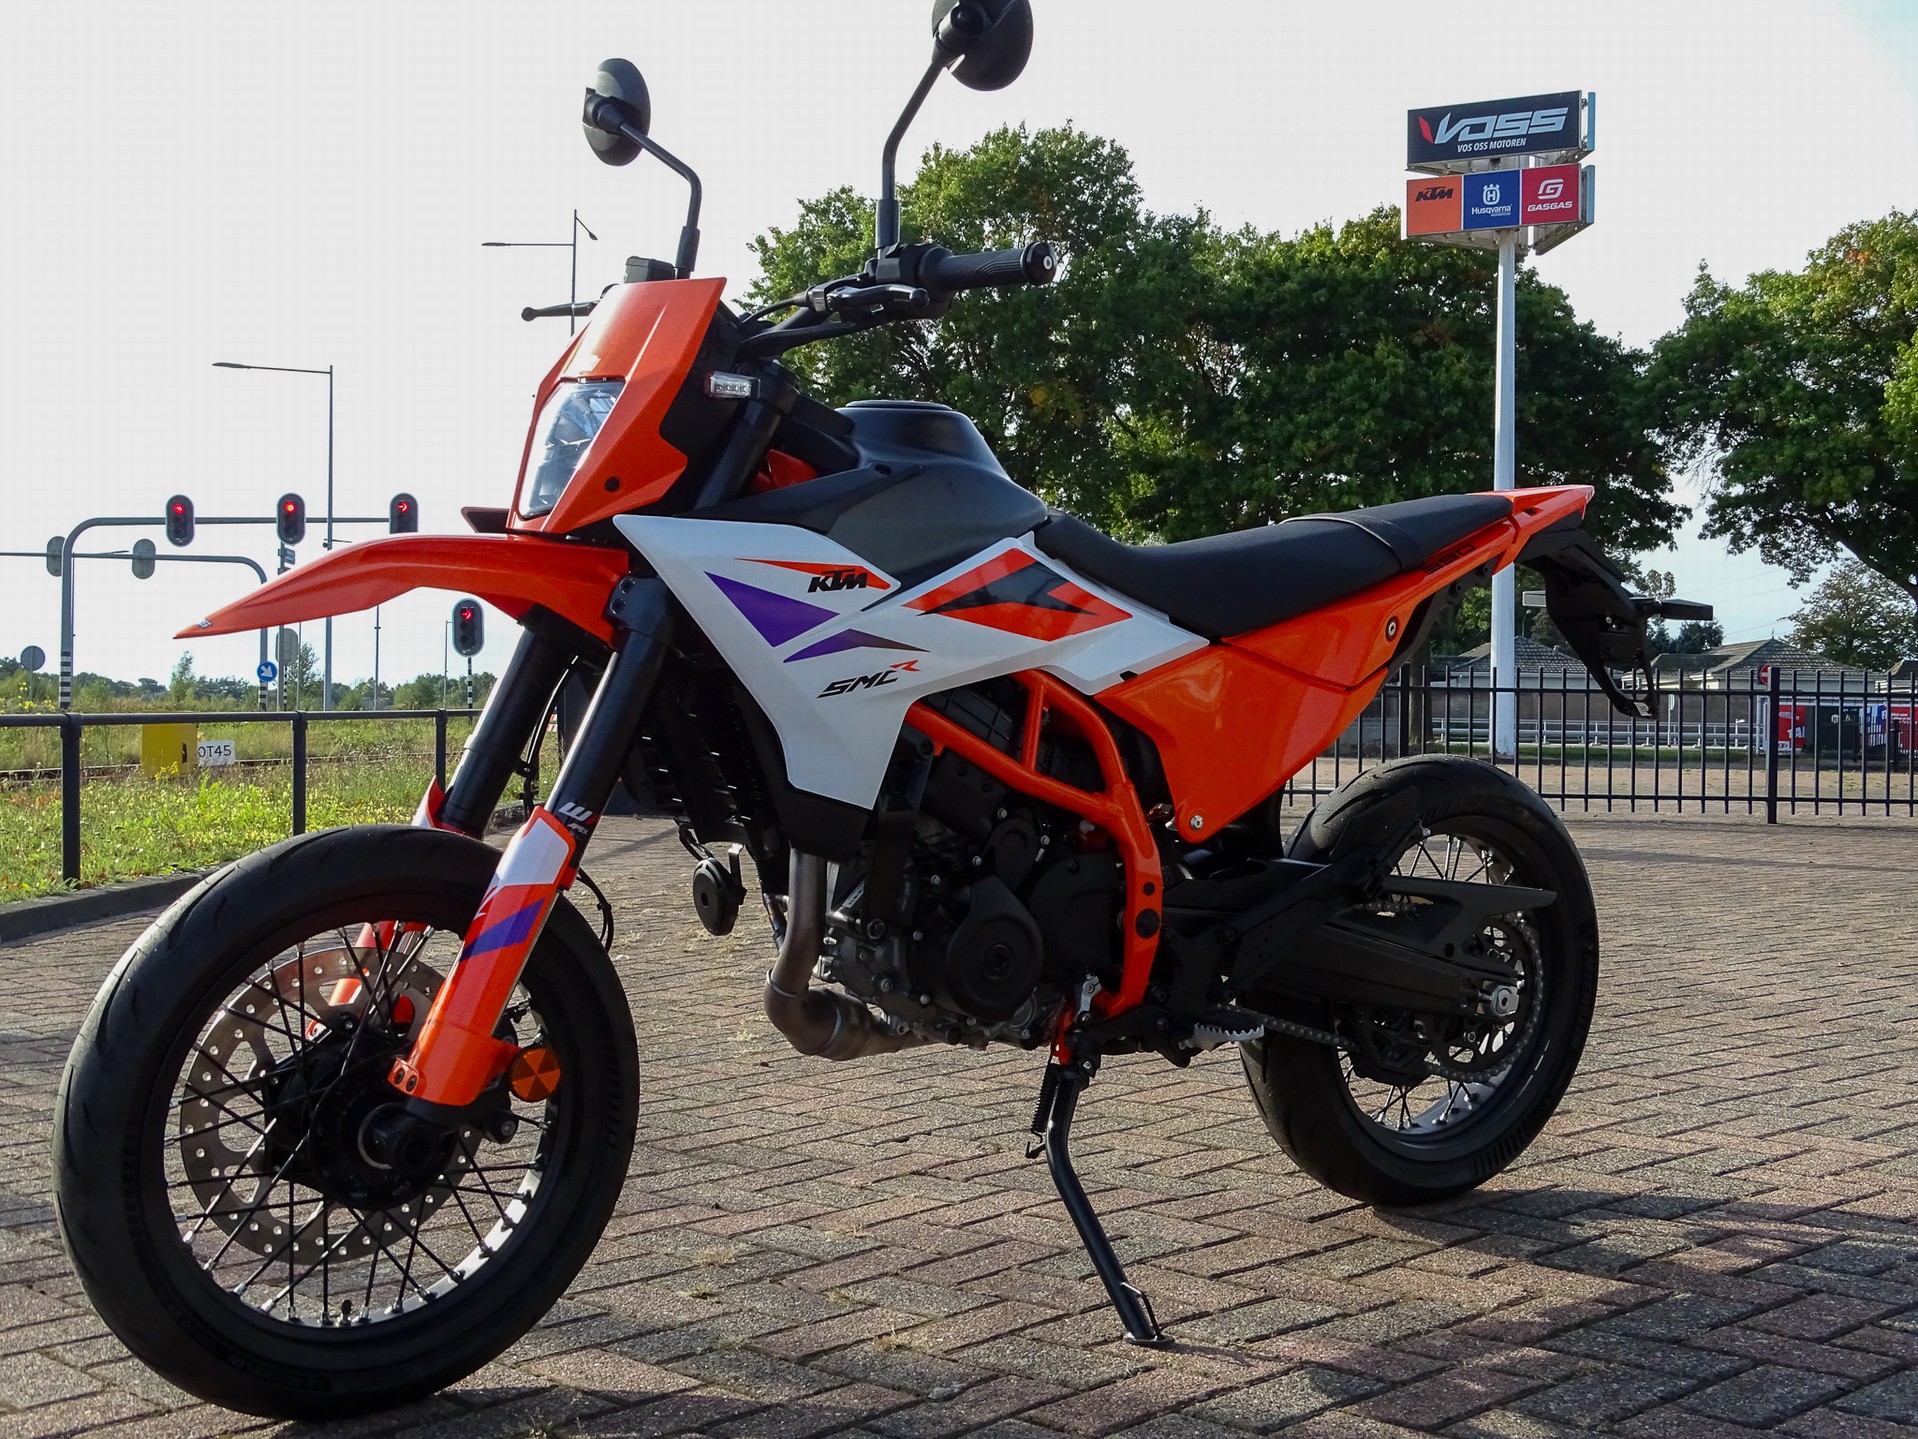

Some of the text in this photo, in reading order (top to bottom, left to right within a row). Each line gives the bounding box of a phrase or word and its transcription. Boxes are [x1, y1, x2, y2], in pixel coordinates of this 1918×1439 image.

[1418, 107, 1569, 144] VOSS
[1457, 138, 1527, 153] VOS OSS MOTOREN
[1415, 186, 1454, 202] KTM
[1471, 205, 1512, 215] Husqvarna
[1527, 200, 1573, 212] GASGAS
[807, 569, 868, 593] KTM
[816, 670, 899, 699] SMC
[566, 822, 590, 835] APEX
